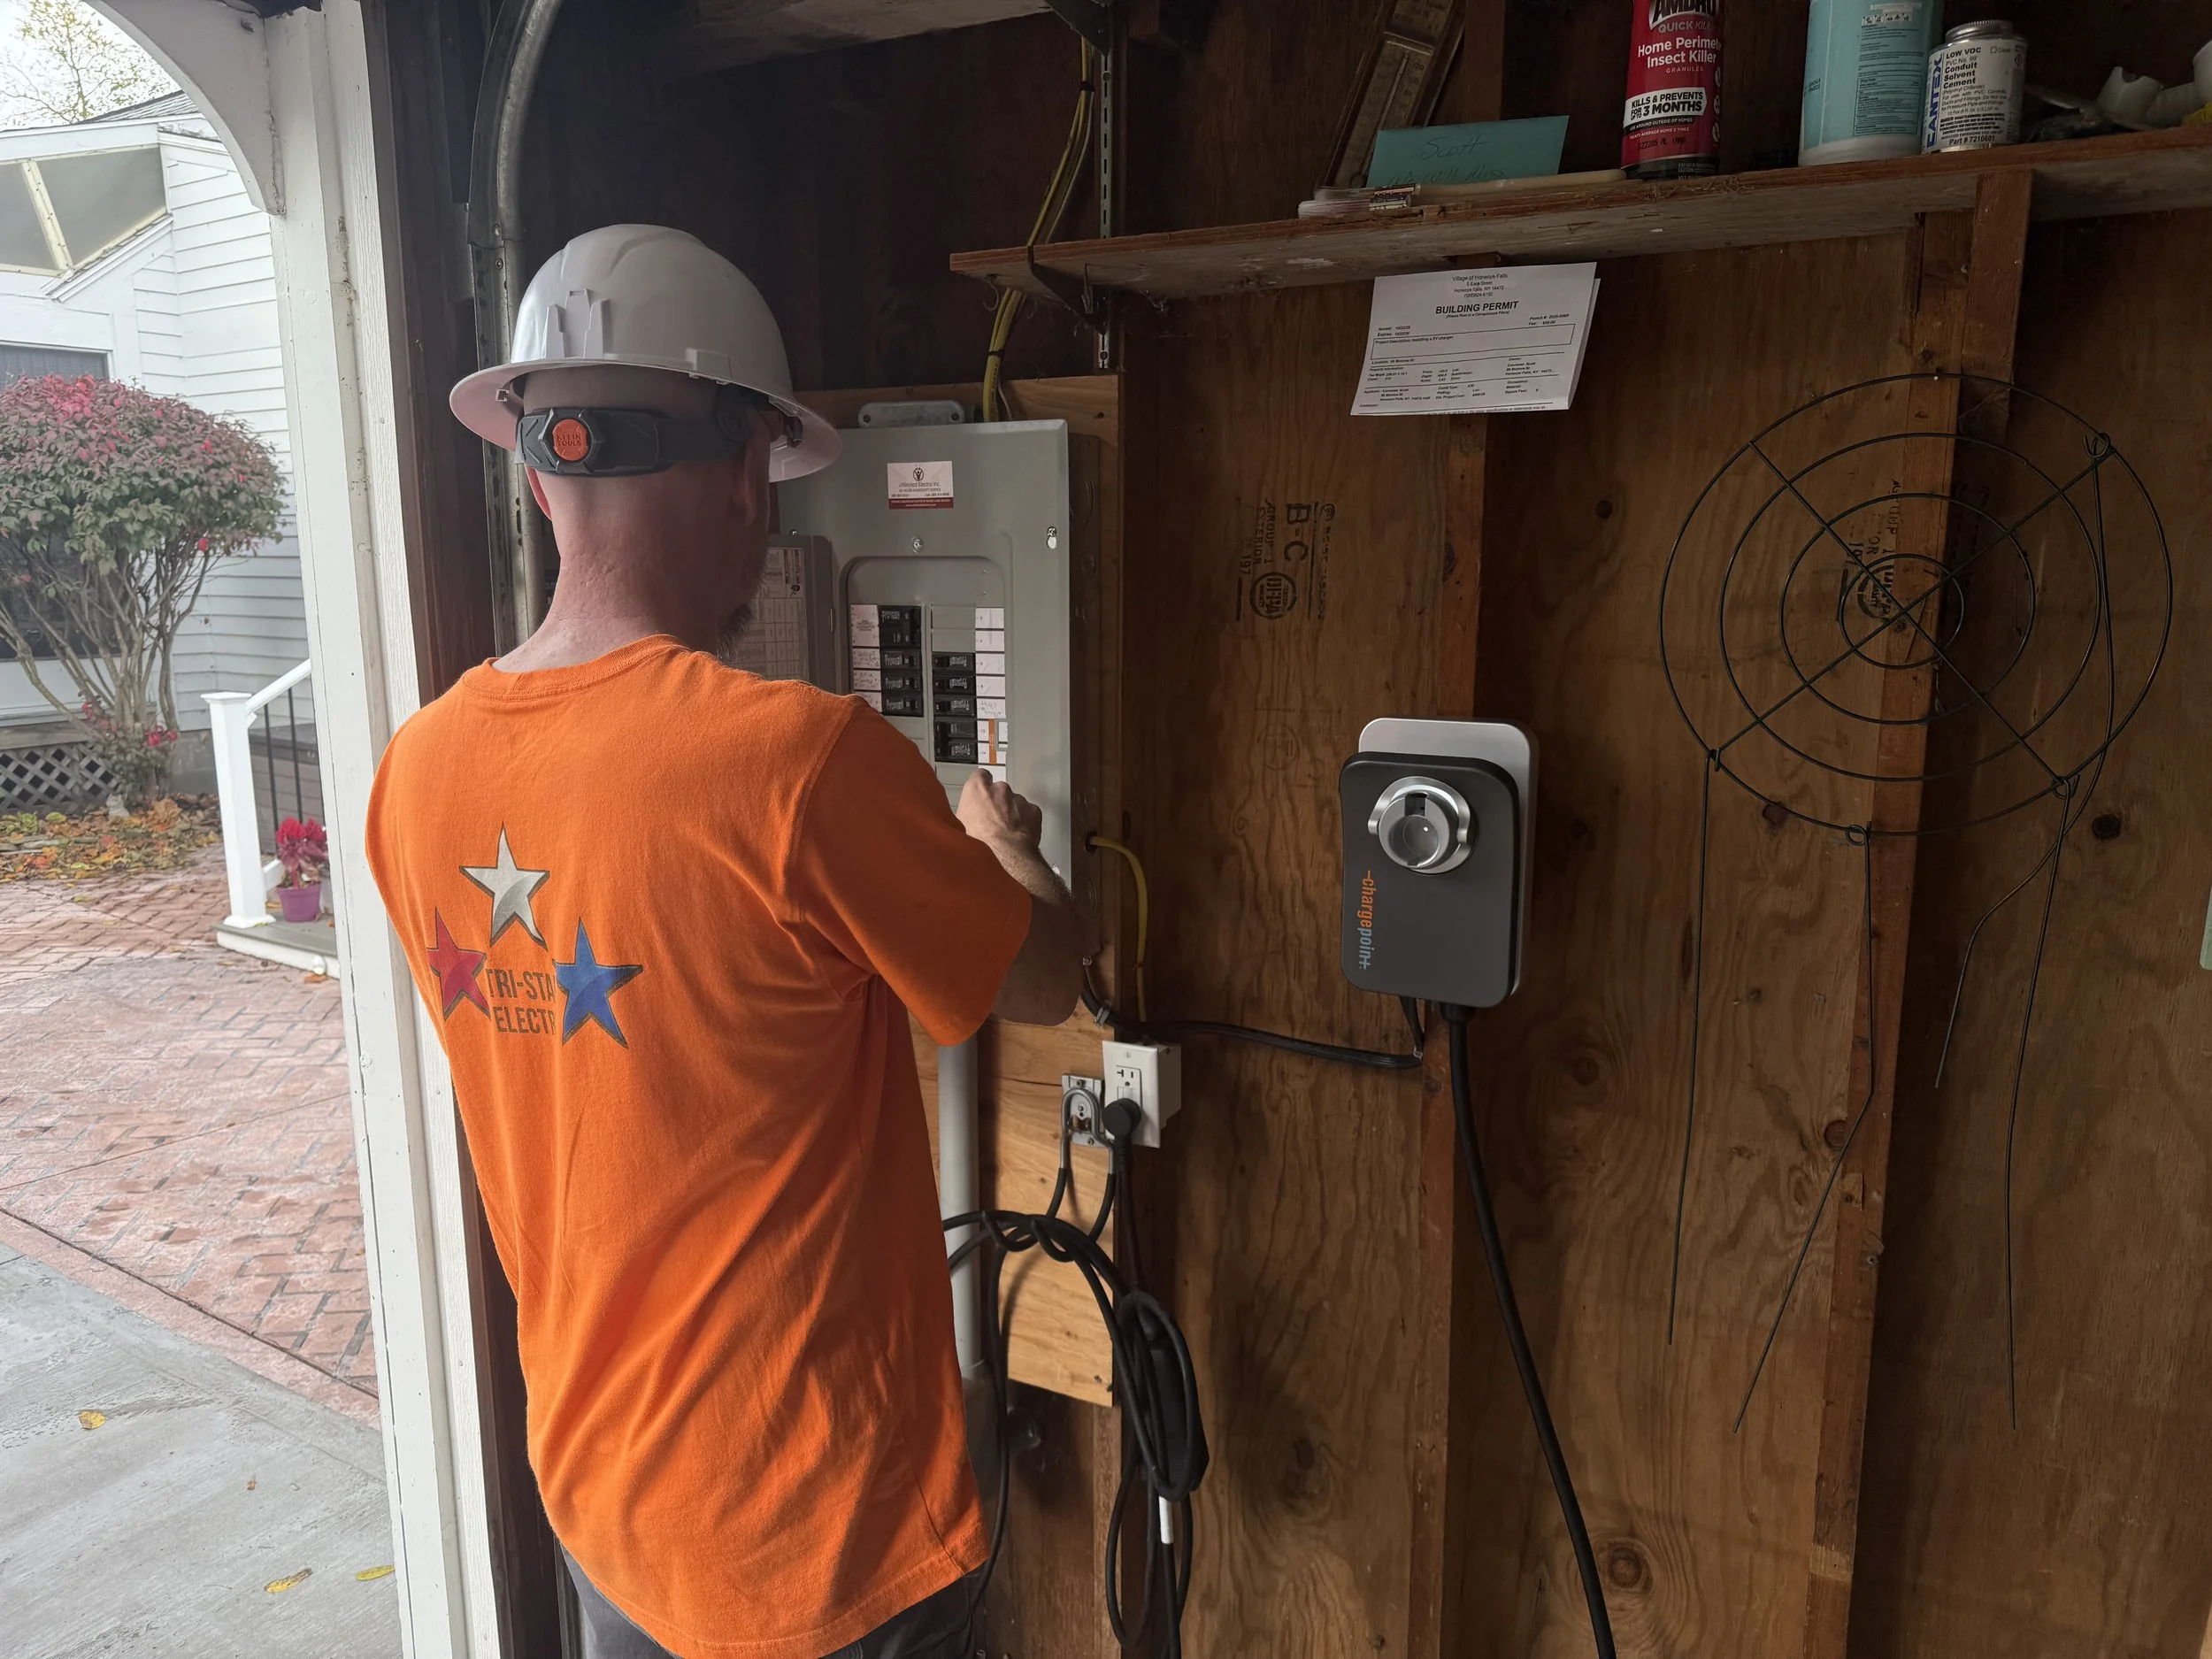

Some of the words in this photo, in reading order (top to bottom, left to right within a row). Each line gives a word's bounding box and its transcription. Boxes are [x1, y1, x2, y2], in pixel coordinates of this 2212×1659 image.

[1658, 21, 1694, 33] QUICK
[1694, 20, 1711, 30] KILL
[1638, 41, 1672, 58] Home
[1946, 50, 1962, 59] LOW
[1647, 50, 1686, 68] Insect
[1689, 50, 1717, 64] Killer
[1946, 58, 1957, 67] PVC
[1944, 61, 1978, 74] Conduit
[1943, 70, 1976, 82] Solvent
[1943, 78, 1976, 89] Cement
[1632, 96, 1651, 109] KILLS
[1652, 95, 1658, 104] &
[1660, 91, 1703, 103] PREVENTS
[1926, 53, 1943, 148] CANTEX
[1643, 105, 1650, 117] 3
[1652, 101, 1702, 115] MONTHS
[1420, 135, 1491, 160] Scott
[1949, 136, 1962, 145] Part
[1435, 303, 1480, 315] BUILDING
[1482, 301, 1519, 311] PERMIT
[1264, 503, 1278, 549] GROUP
[1253, 506, 1265, 565] EXTERIOR
[485, 968, 555, 1003] TRI-STA
